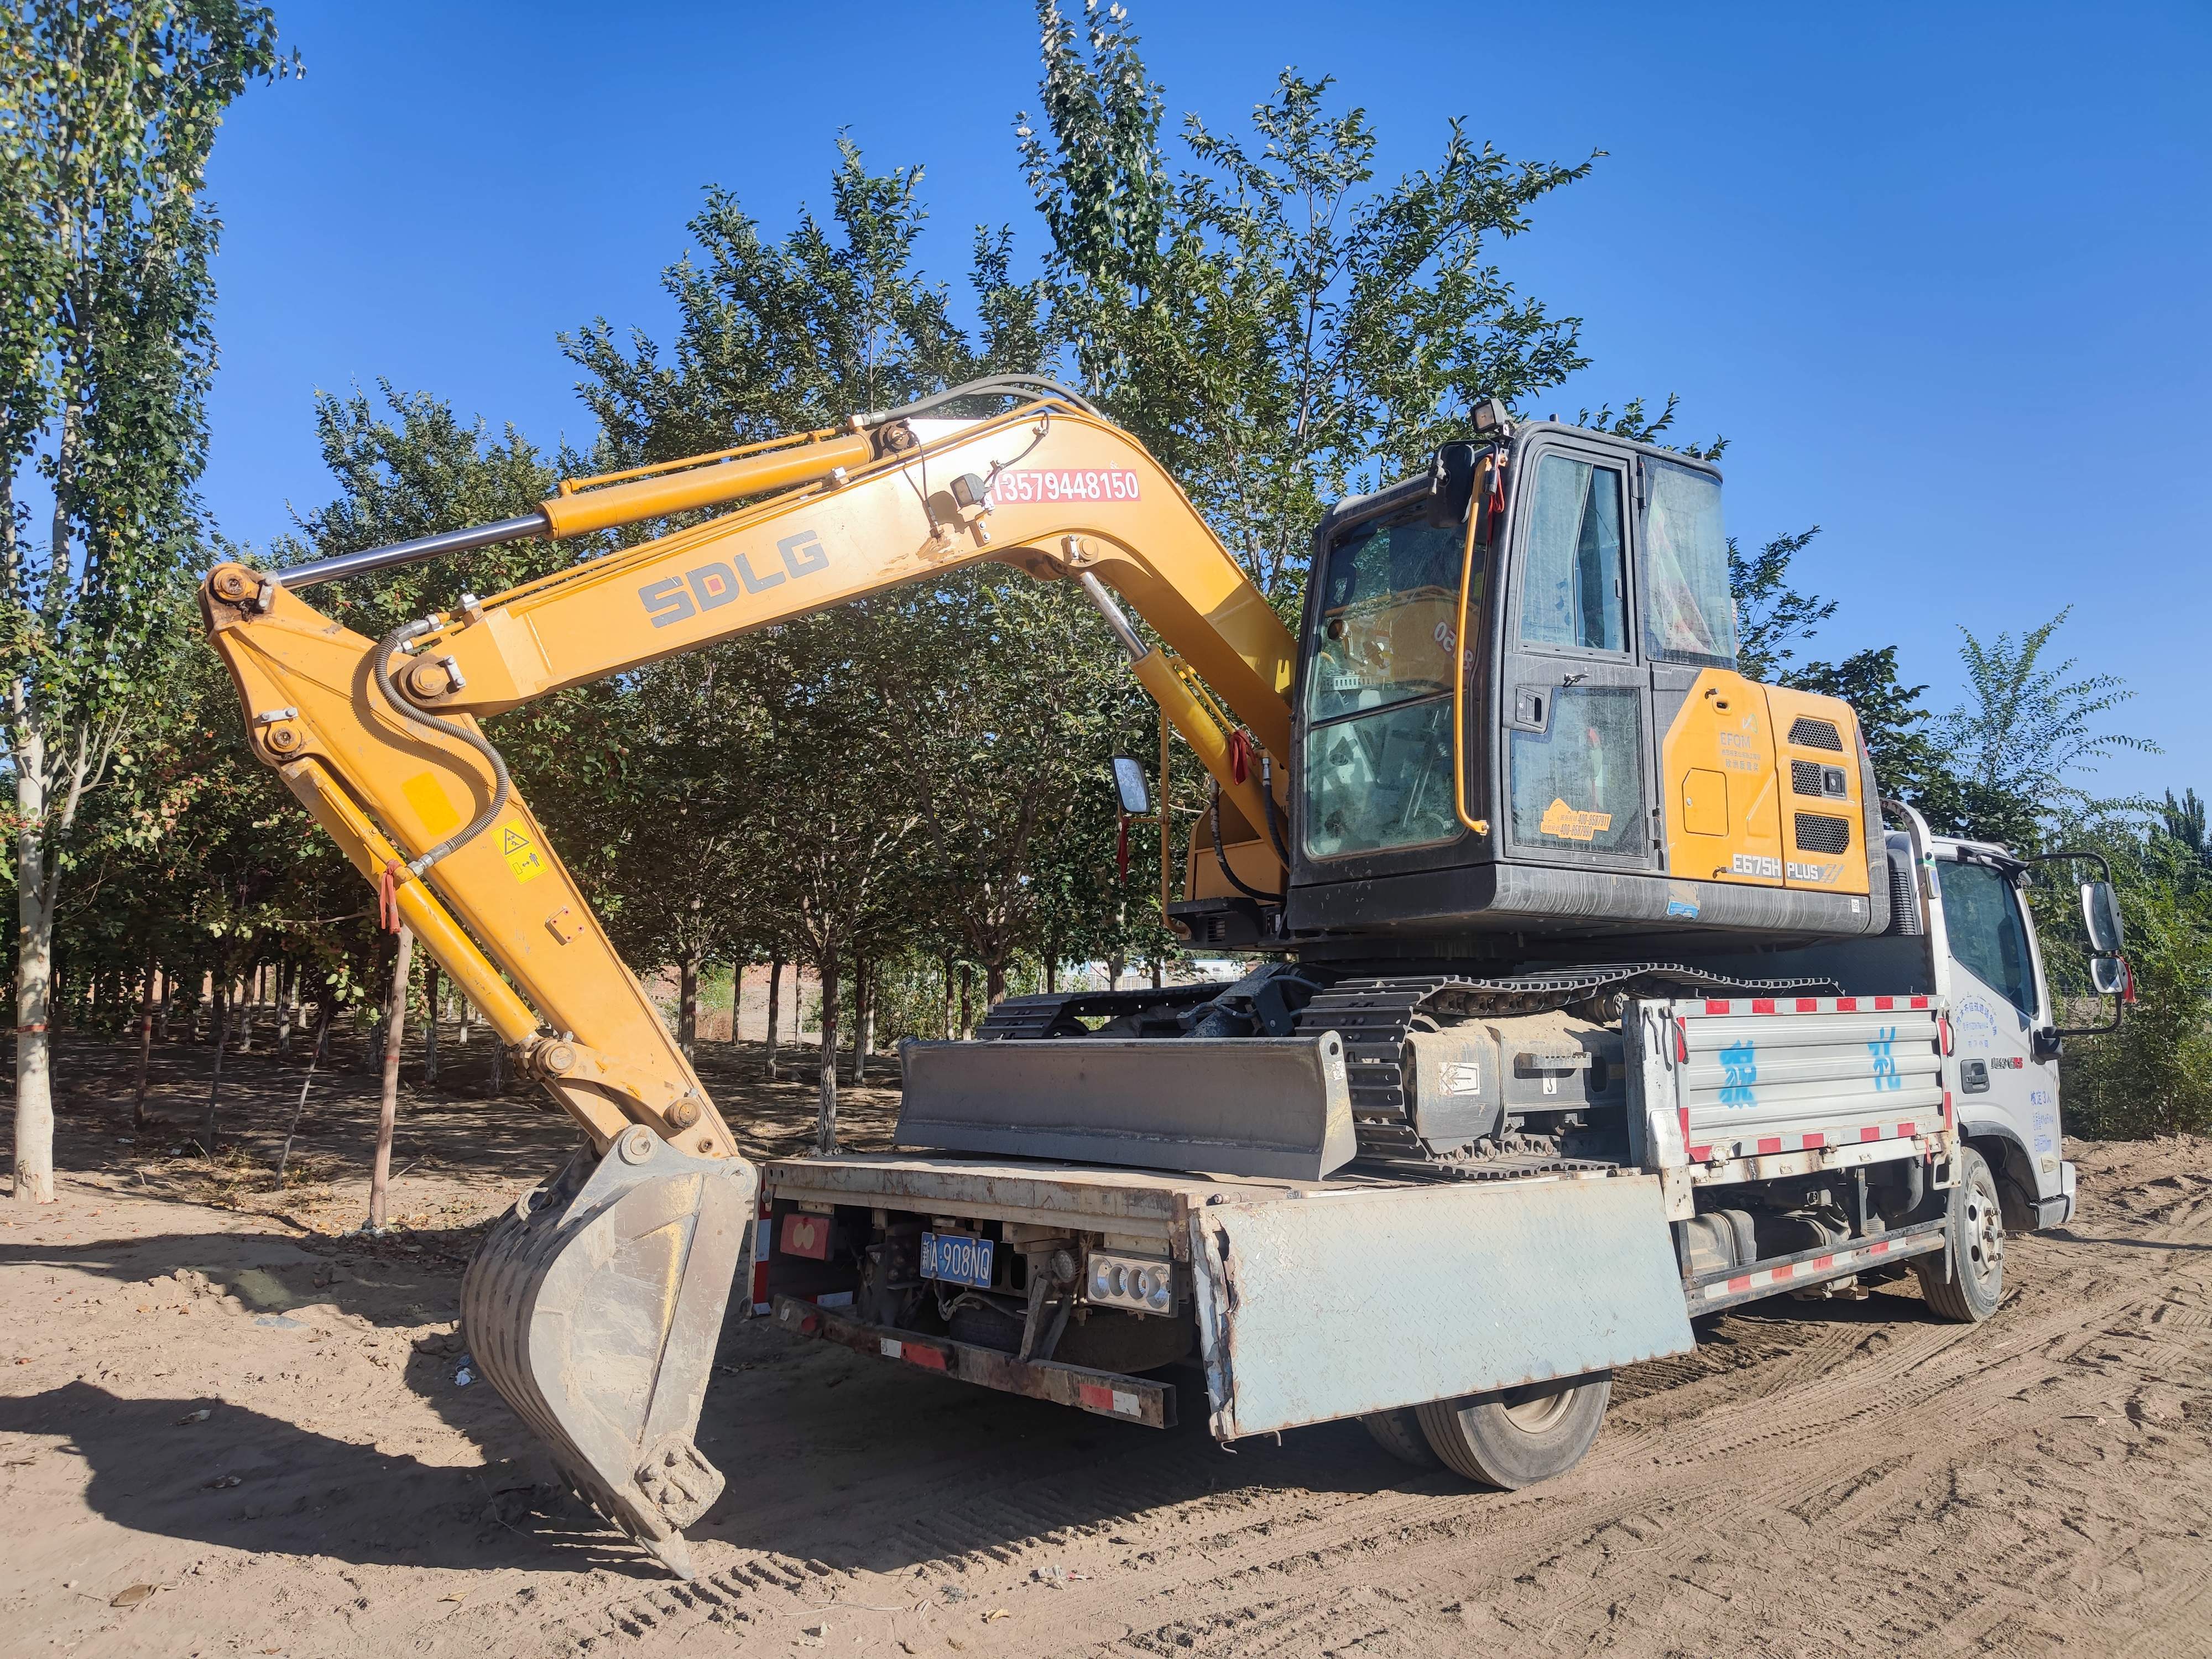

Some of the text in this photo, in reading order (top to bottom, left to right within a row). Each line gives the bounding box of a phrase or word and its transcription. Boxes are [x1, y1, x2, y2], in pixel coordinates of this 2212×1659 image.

[994, 472, 1139, 501] 13579448150
[638, 529, 829, 628] SDLG
[1720, 732, 1751, 748] EFQM
[1733, 853, 1819, 880] E675H PLUS
